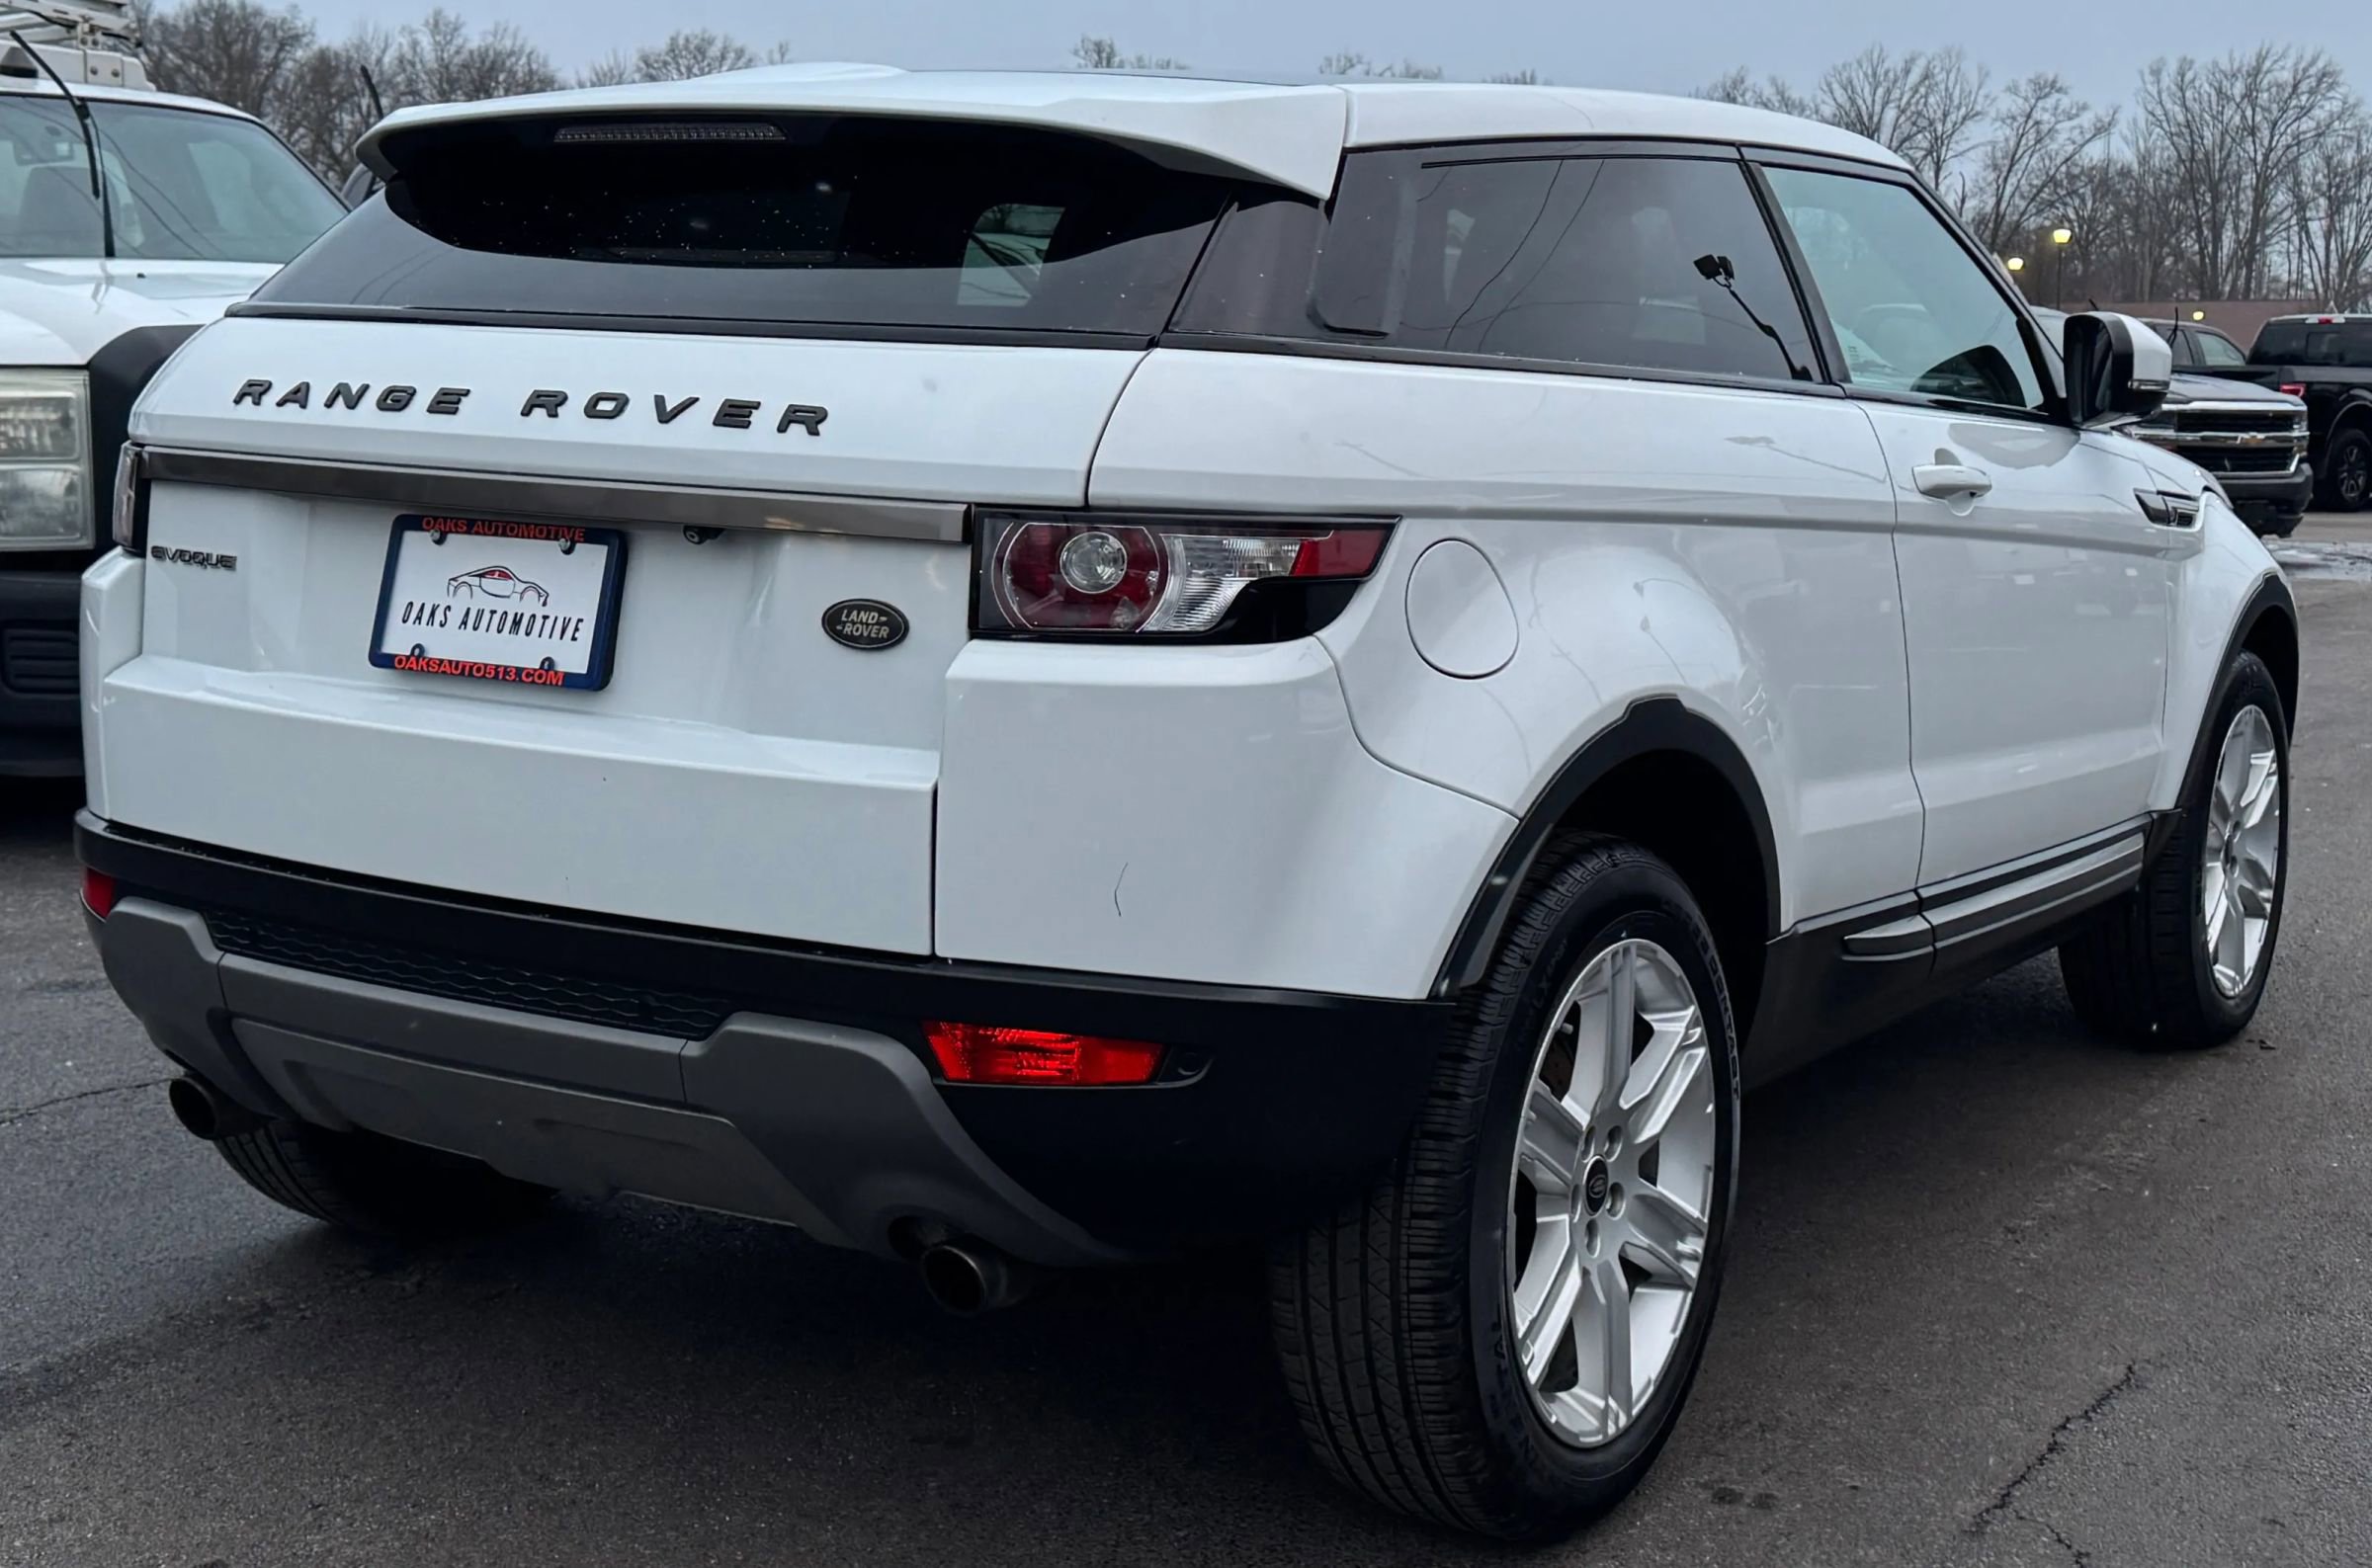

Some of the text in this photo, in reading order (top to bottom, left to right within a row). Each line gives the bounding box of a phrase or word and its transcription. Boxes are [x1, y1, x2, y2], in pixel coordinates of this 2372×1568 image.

[233, 379, 828, 437] RANGE ROVER
[422, 517, 586, 542] OAKS AUTOMOTIVE
[151, 545, 237, 571] EVOQUE
[401, 601, 584, 642] OAKS AUTOMOTIVE
[394, 656, 563, 686] OAKSAUTO513.COM
